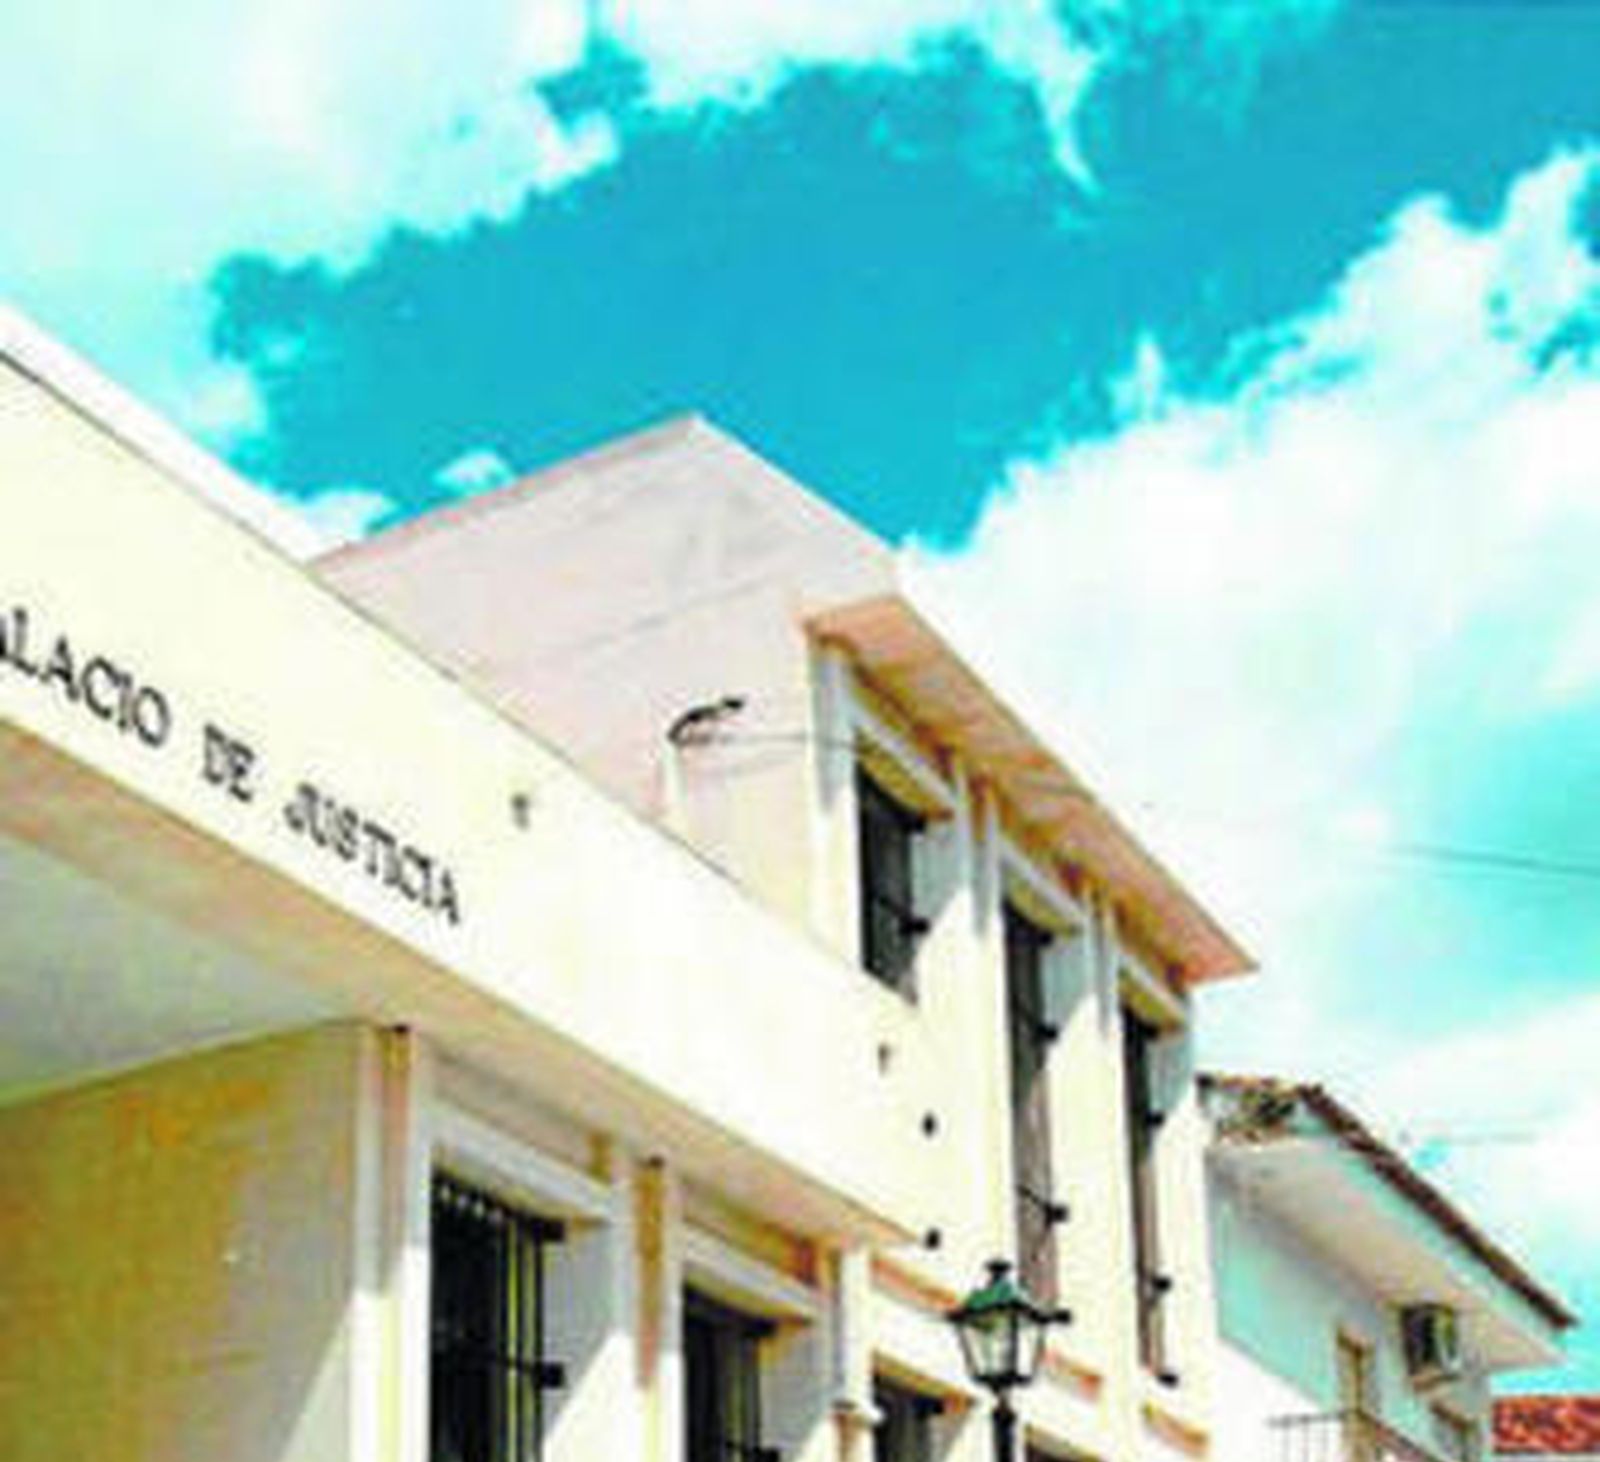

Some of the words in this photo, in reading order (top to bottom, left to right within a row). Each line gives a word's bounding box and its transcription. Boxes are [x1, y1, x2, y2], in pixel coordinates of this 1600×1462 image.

[0, 608, 170, 748] LACIO
[203, 724, 255, 803] DE
[284, 784, 459, 925] JUSTICIA
